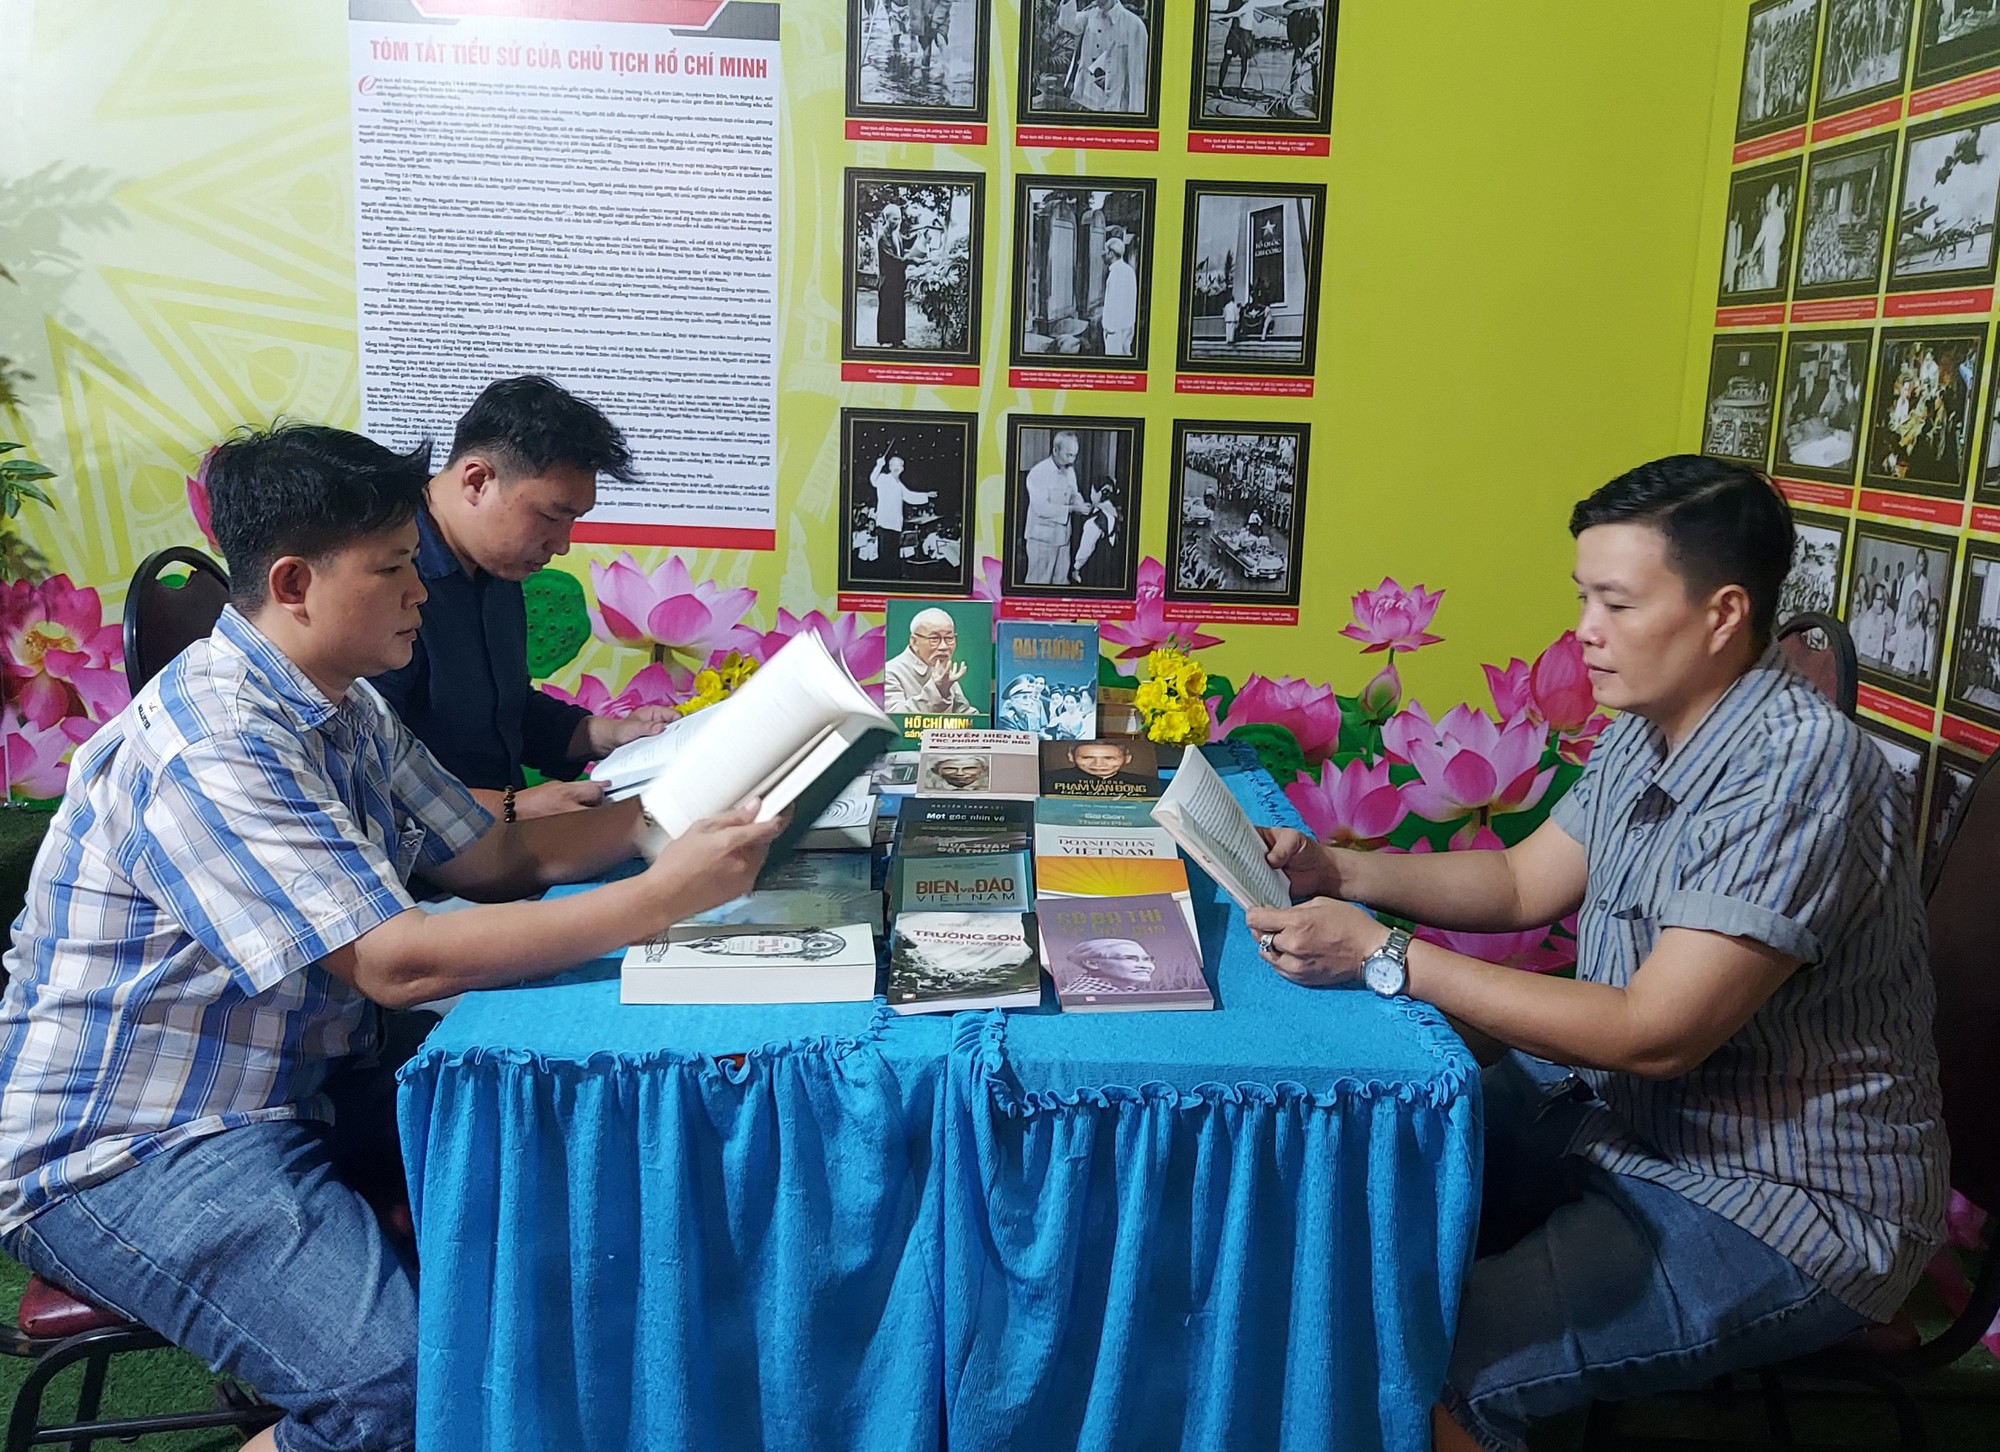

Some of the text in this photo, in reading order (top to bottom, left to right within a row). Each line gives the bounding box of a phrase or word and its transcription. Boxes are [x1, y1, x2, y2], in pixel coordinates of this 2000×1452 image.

[370, 36, 767, 78] TÓM TẮT TIỂU SỬ CỦA CHỦ TỊCH HỒ CHÍ MINH
[904, 715, 973, 730] HỒ CHÍ MINH
[1111, 848, 1154, 856] NAM
[971, 892, 1015, 901] NAM
[987, 933, 1021, 941] SƠN
